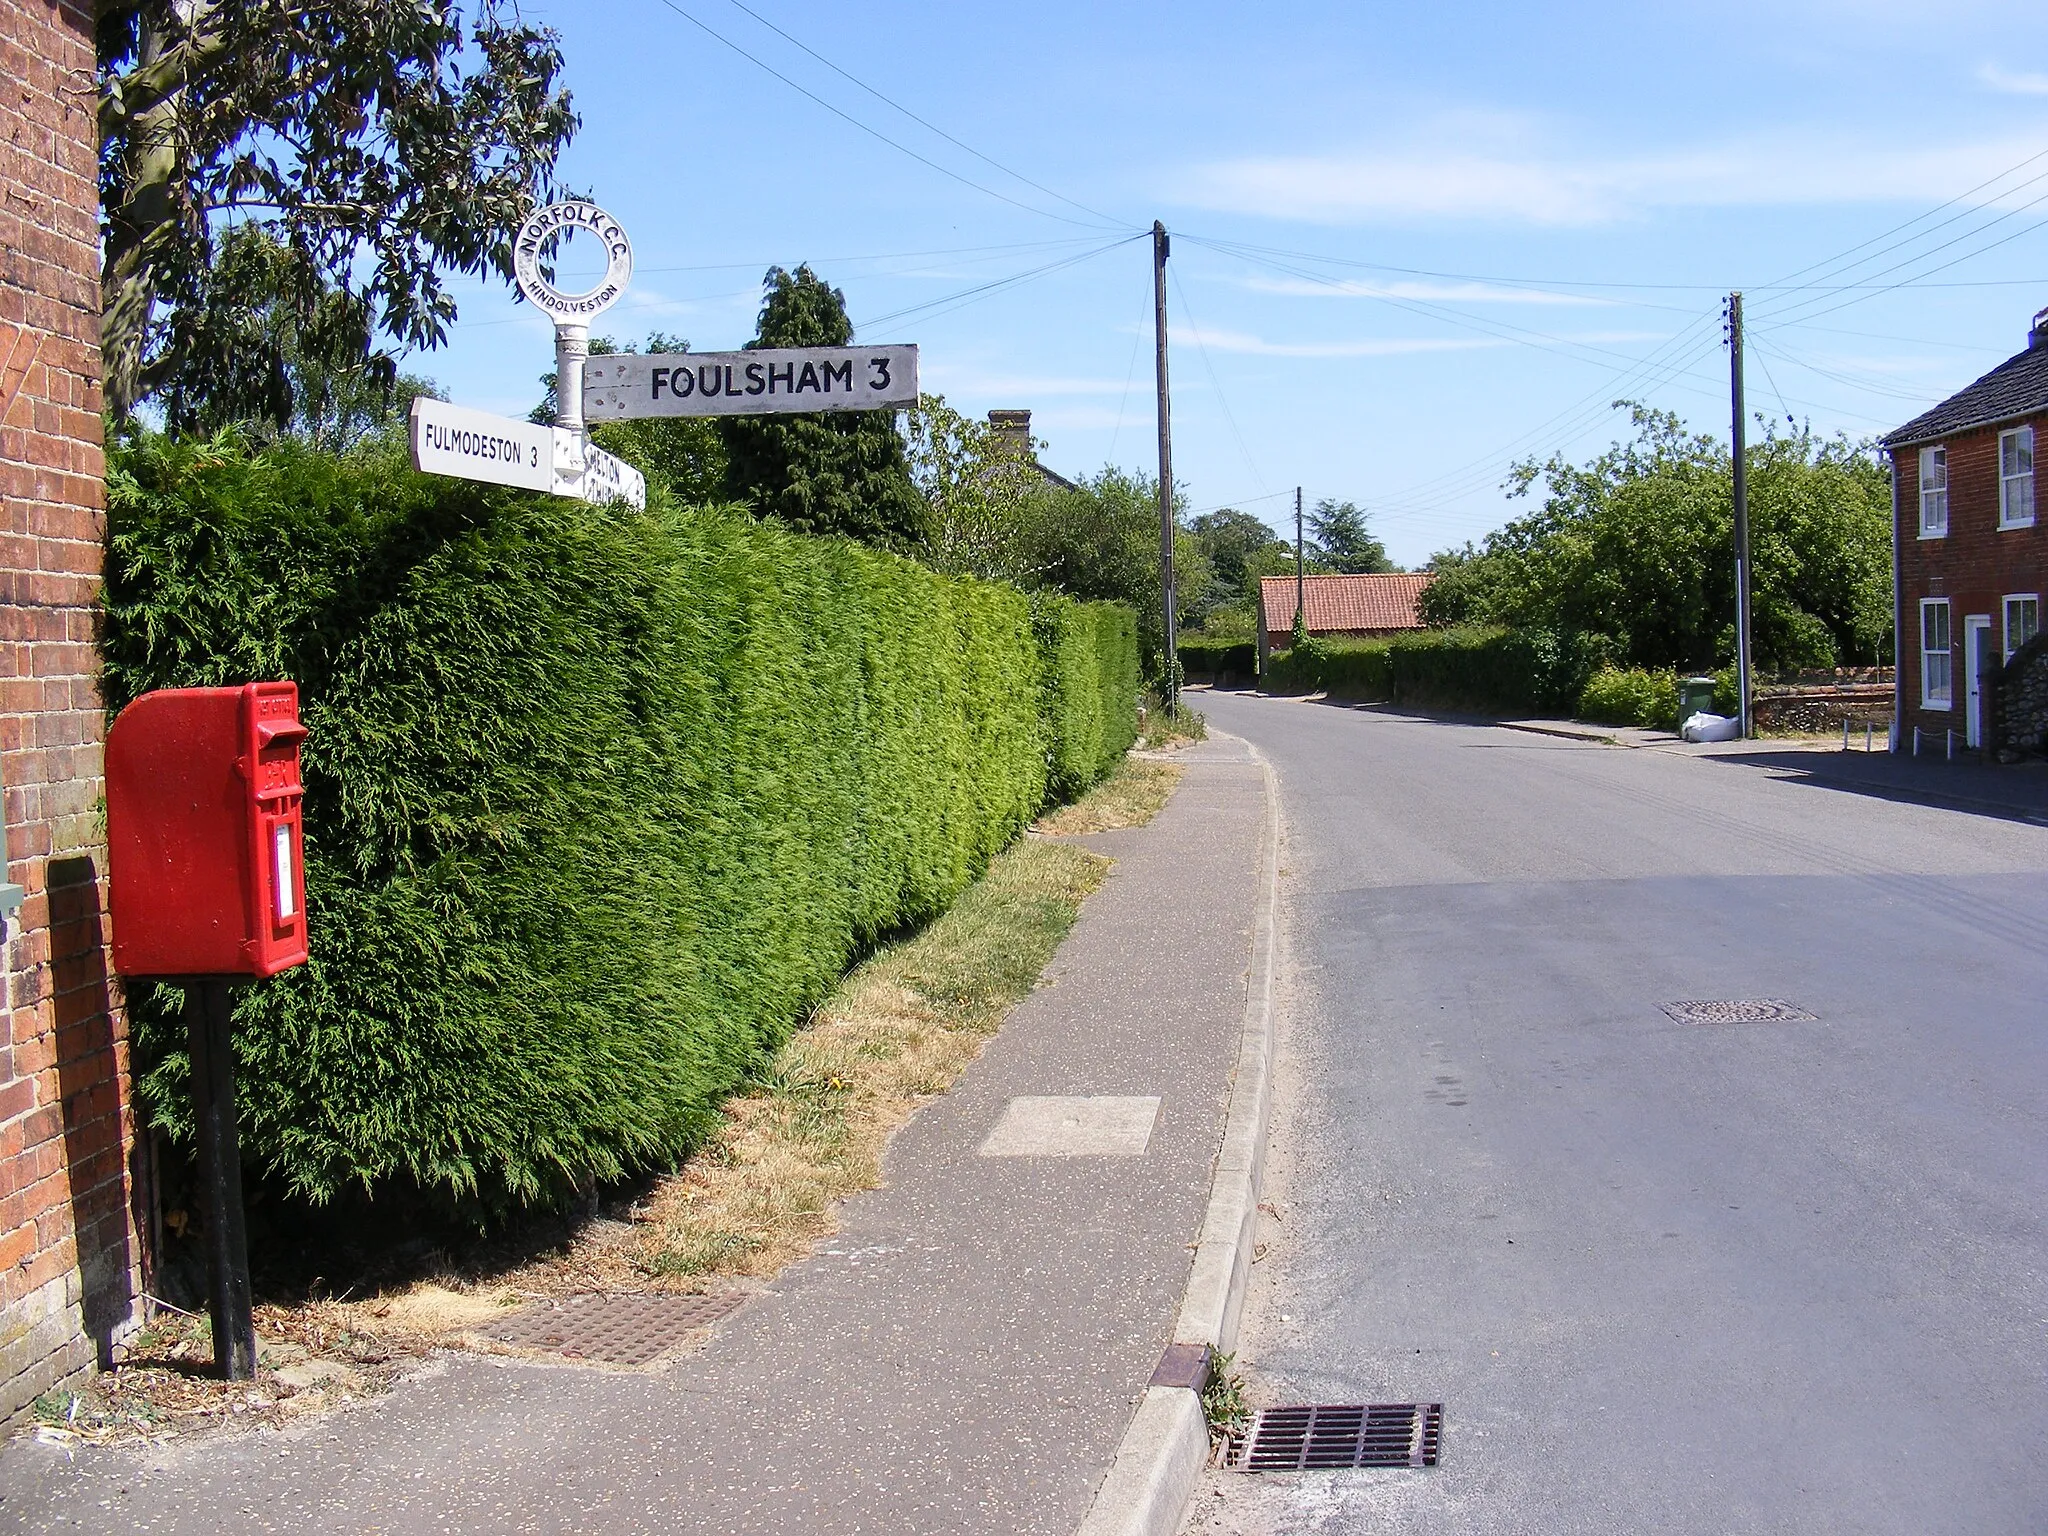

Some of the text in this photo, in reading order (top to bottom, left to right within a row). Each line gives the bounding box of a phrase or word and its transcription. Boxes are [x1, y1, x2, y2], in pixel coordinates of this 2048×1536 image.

[519, 205, 606, 257] NORFOLK
[528, 280, 618, 313] HINDOLVESTON
[652, 357, 892, 400] FOULSHAM 3
[425, 423, 539, 468] FULMODESTON 3
